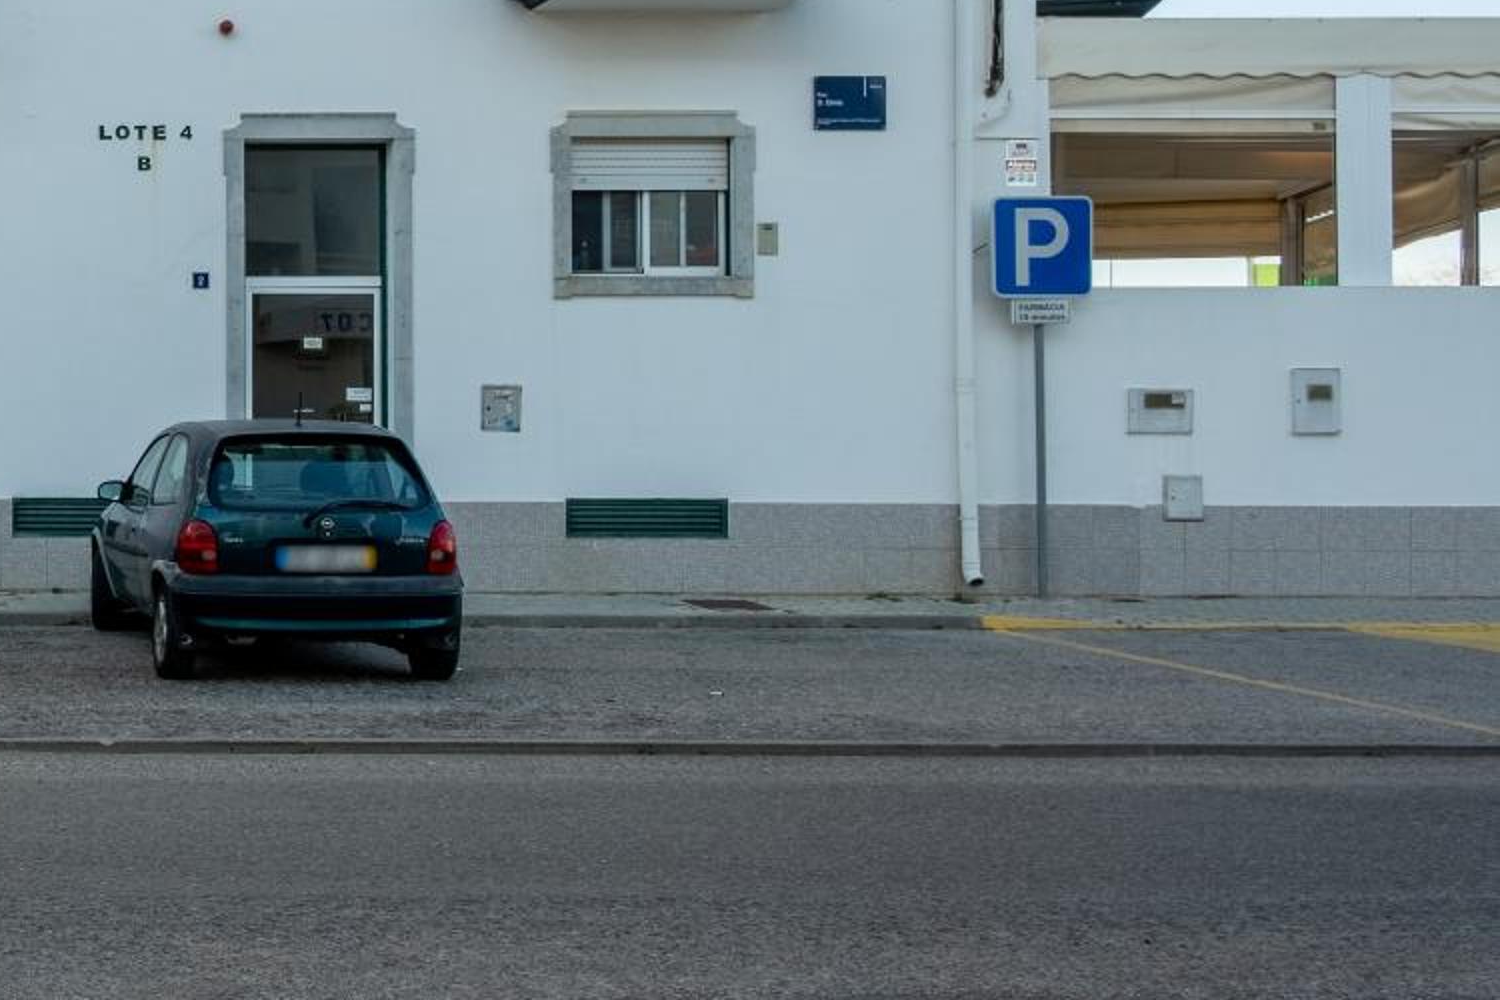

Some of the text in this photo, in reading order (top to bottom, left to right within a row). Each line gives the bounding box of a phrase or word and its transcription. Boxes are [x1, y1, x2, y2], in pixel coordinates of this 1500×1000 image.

[99, 125, 192, 141] LOTE 4
[137, 156, 151, 171] B
[1015, 207, 1070, 287] P
